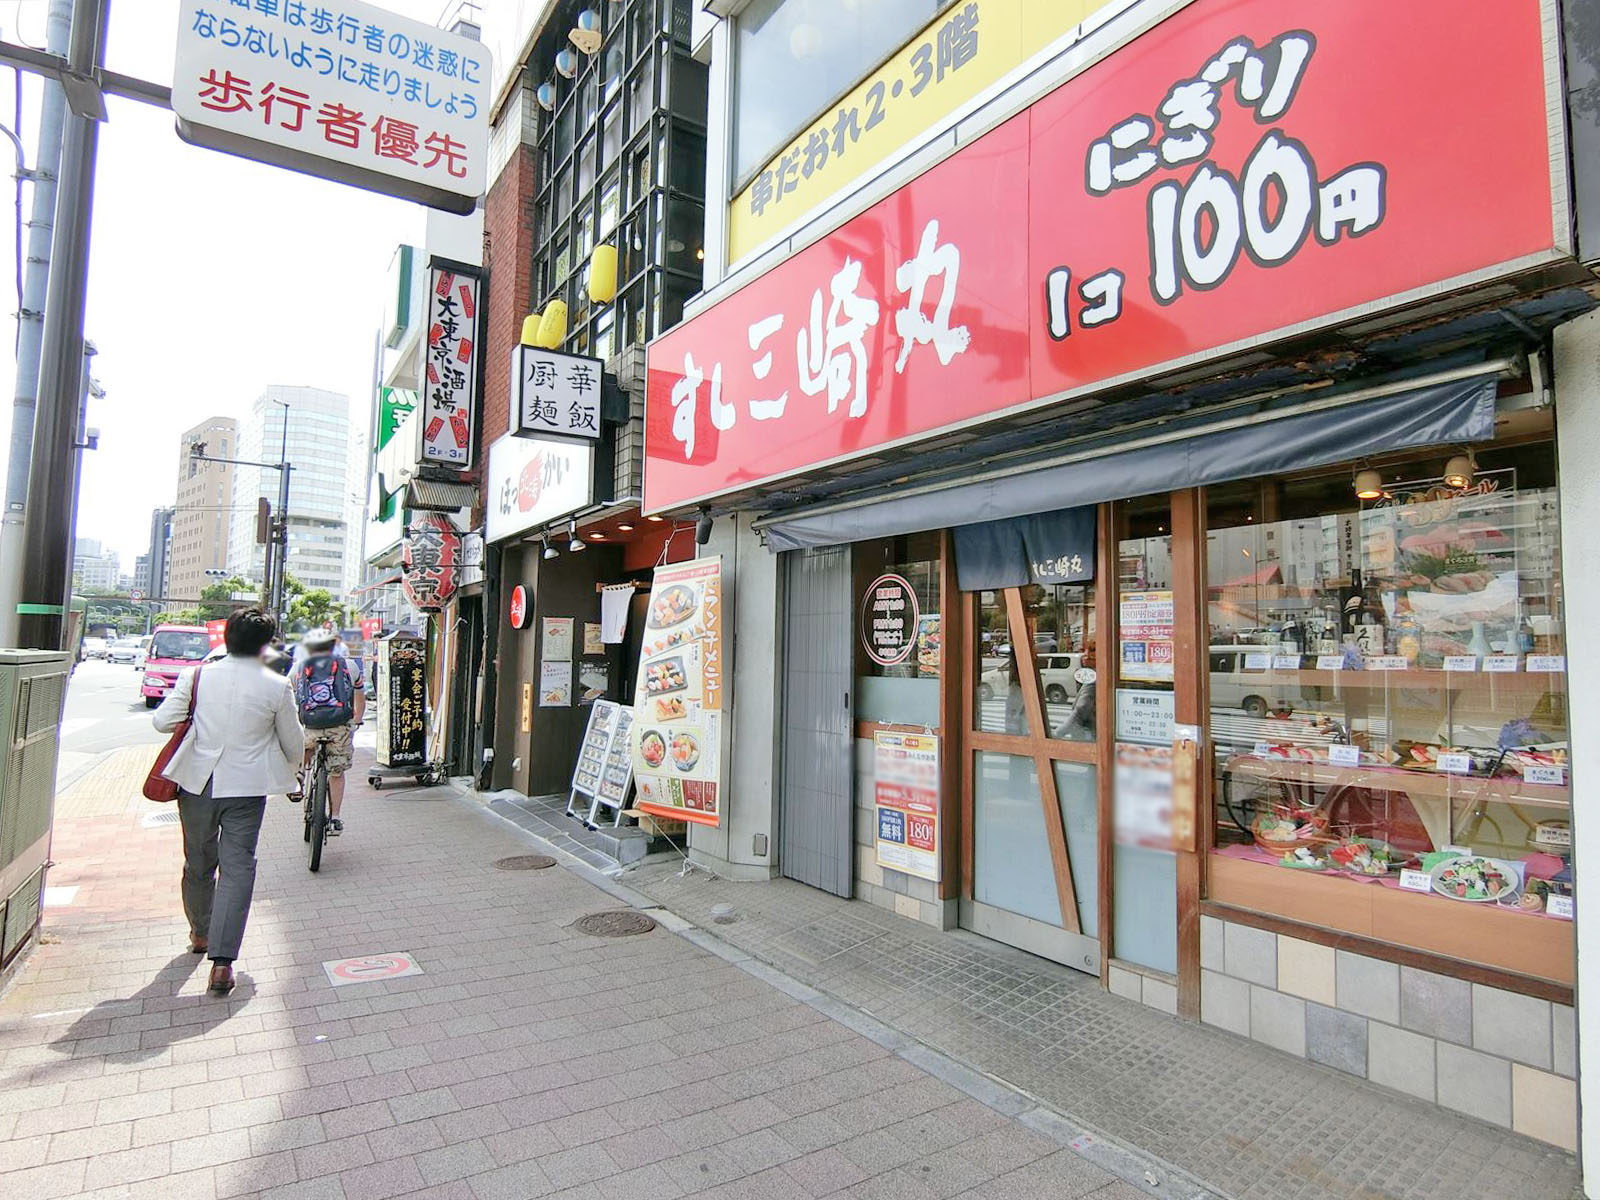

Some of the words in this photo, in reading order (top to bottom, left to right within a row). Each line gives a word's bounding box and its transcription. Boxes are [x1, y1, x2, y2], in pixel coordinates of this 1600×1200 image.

[192, 9, 478, 120] ならないように走りましょう
[750, 2, 980, 217] 串だおれ2・3階
[1087, 34, 1313, 193] にぎり
[198, 68, 468, 179] 歩行者優先
[1148, 129, 1386, 303] 100円
[431, 296, 466, 414] 大東京酒場
[411, 668, 423, 731] 宴会ご予約
[703, 588, 720, 705] ランチメニュー
[881, 822, 902, 841] 無料
[909, 821, 930, 840] 180
